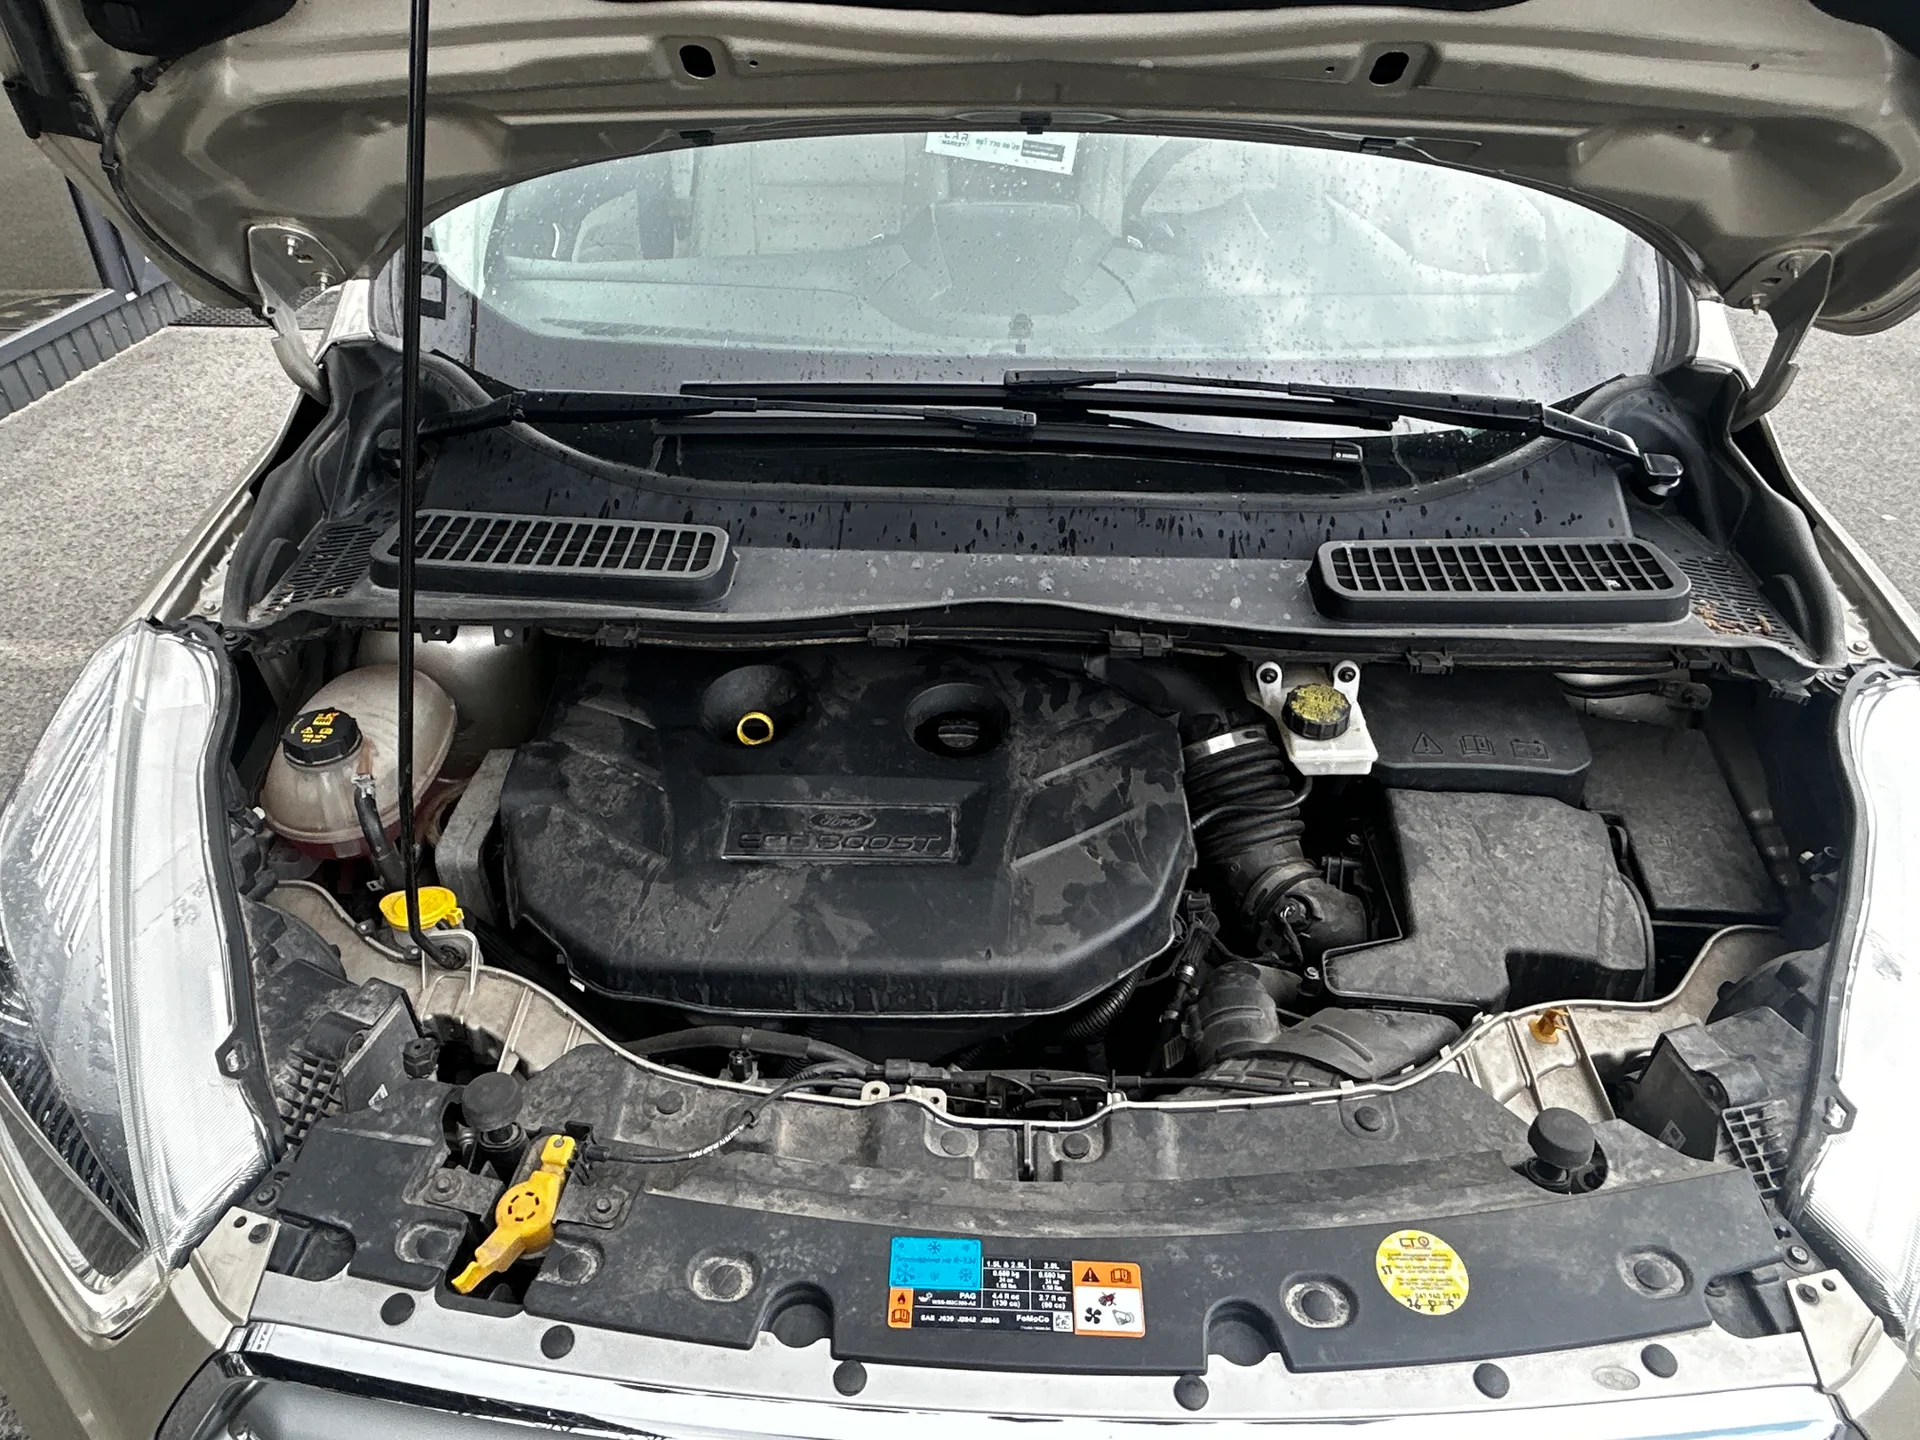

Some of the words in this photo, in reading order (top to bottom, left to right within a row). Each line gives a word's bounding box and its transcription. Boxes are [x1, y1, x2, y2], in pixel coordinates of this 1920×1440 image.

[819, 812, 863, 828] Ford
[738, 833, 942, 850] ECOBOOST
[959, 1292, 977, 1300] PAG
[1016, 1314, 1050, 1323] FoMoCo
